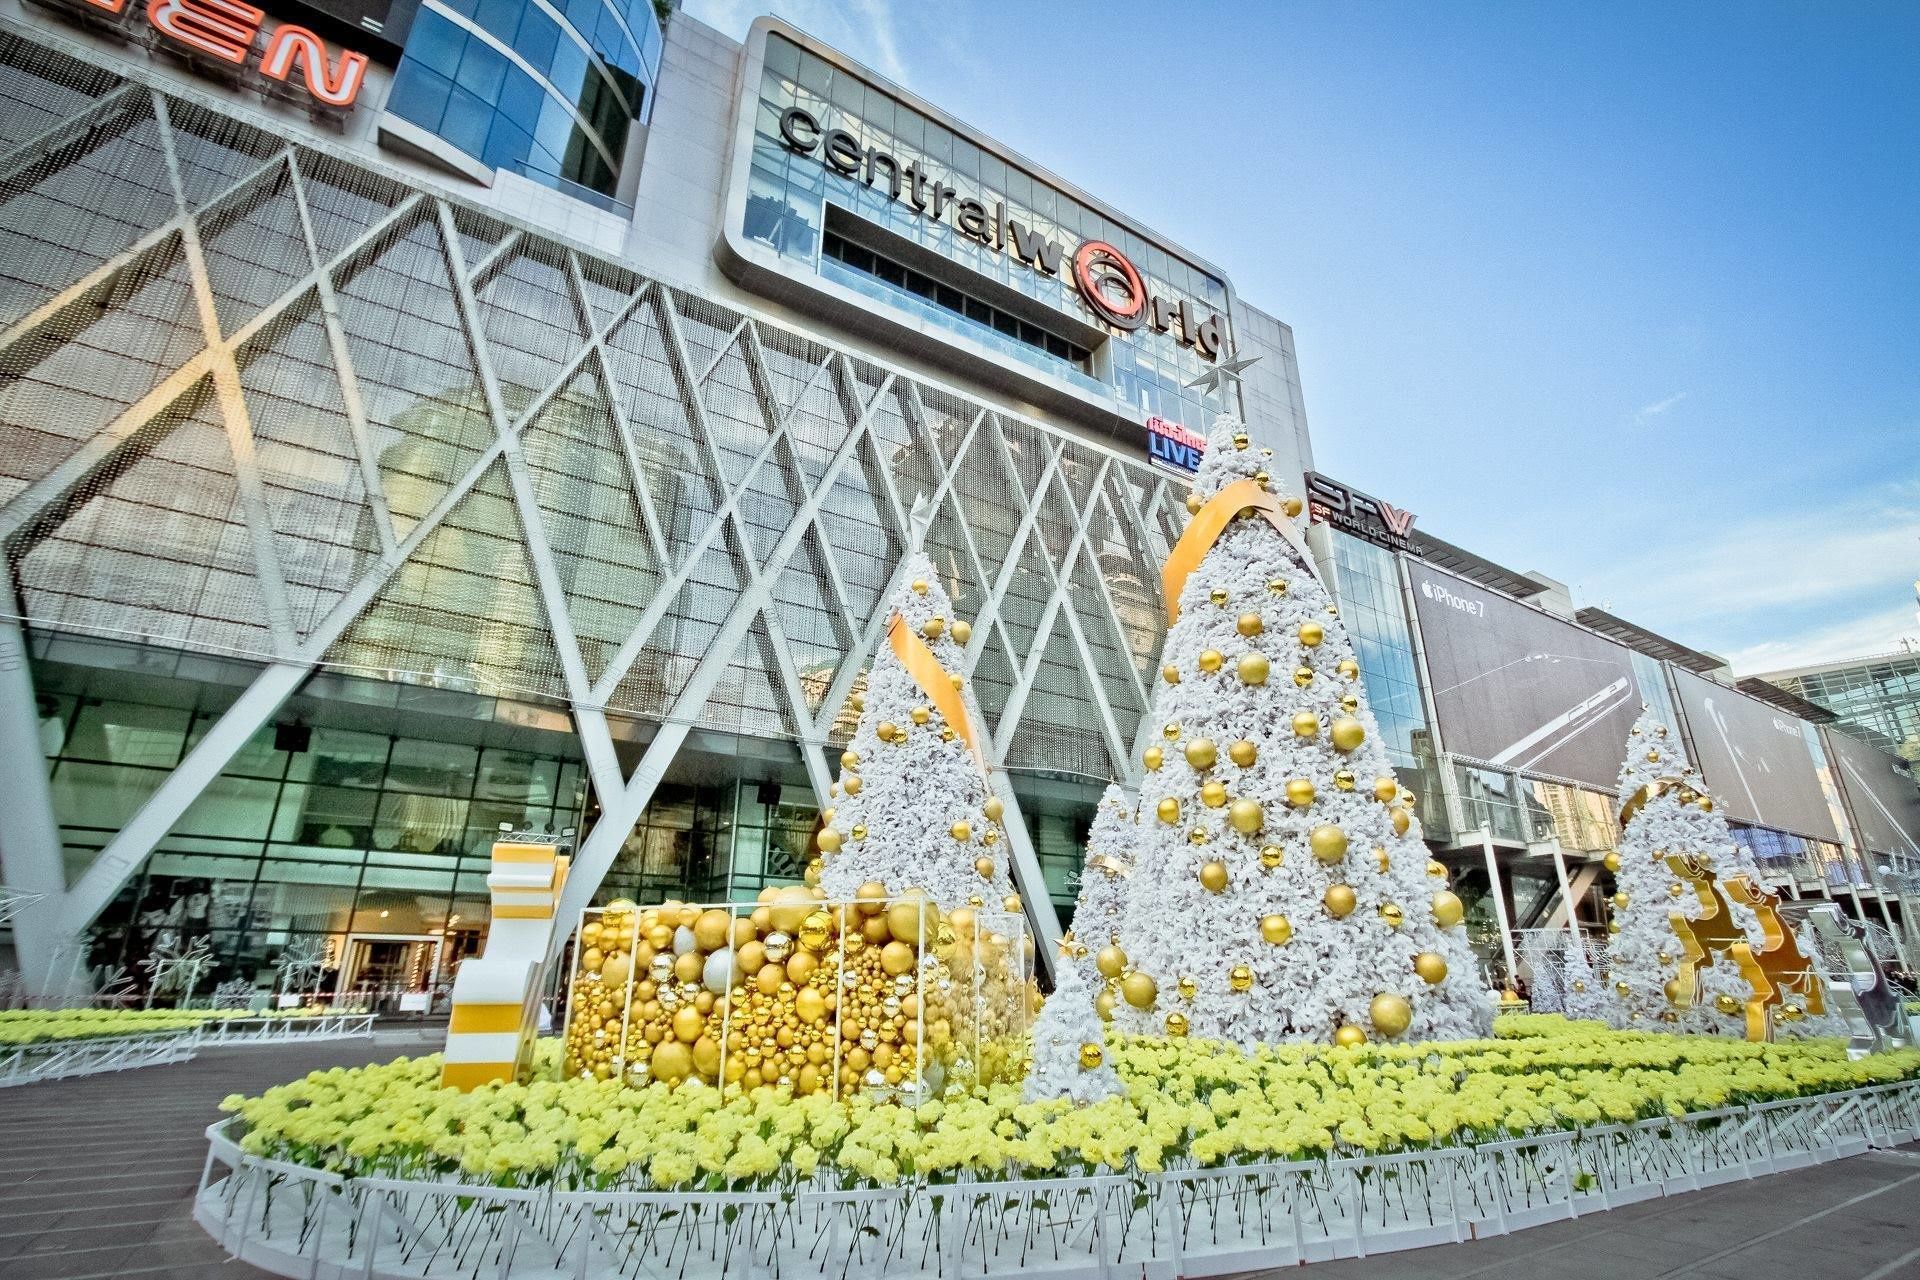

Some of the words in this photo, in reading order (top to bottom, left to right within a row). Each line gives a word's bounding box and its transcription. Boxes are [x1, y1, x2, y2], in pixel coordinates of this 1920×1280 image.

[82, 0, 370, 107] EN
[778, 106, 1226, 361] centralworld
[1149, 431, 1200, 471] LIVE
[1311, 502, 1331, 516] SF
[1332, 510, 1377, 537] WORLD
[1379, 532, 1424, 556] CINEMA
[1432, 583, 1477, 615] iPhone
[1475, 600, 1484, 617] 7
